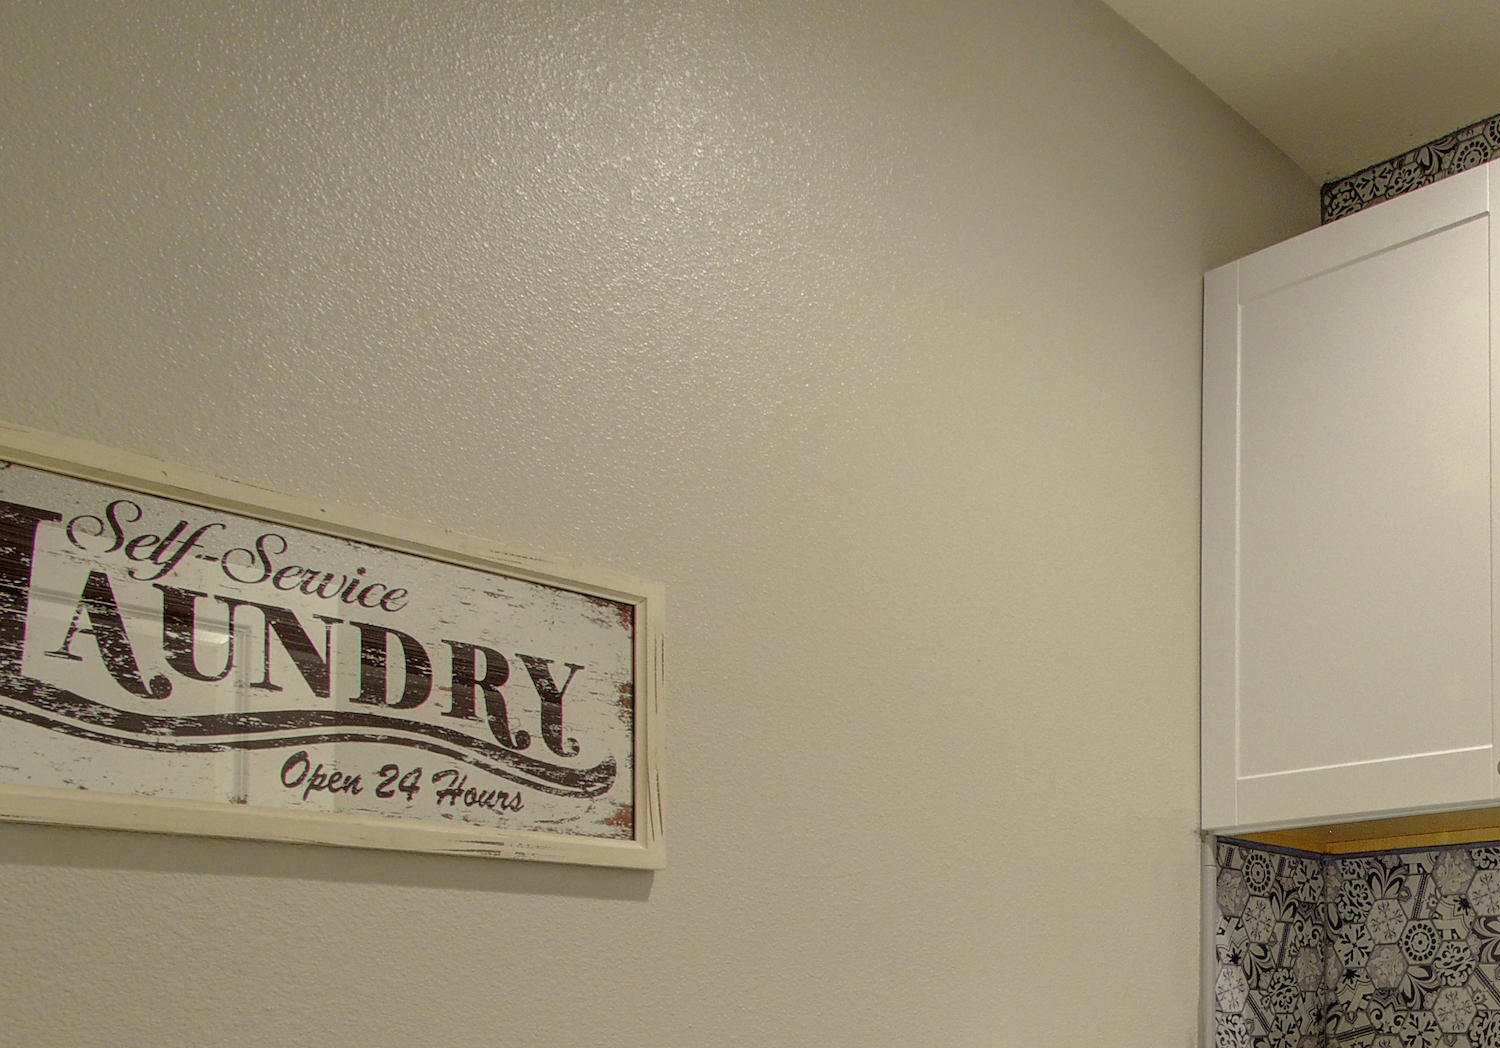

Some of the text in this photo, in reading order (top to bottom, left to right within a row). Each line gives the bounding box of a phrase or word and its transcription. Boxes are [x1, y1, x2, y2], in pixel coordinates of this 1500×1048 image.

[66, 499, 409, 612] Self-Service
[281, 751, 525, 813] Open 24 Hours
